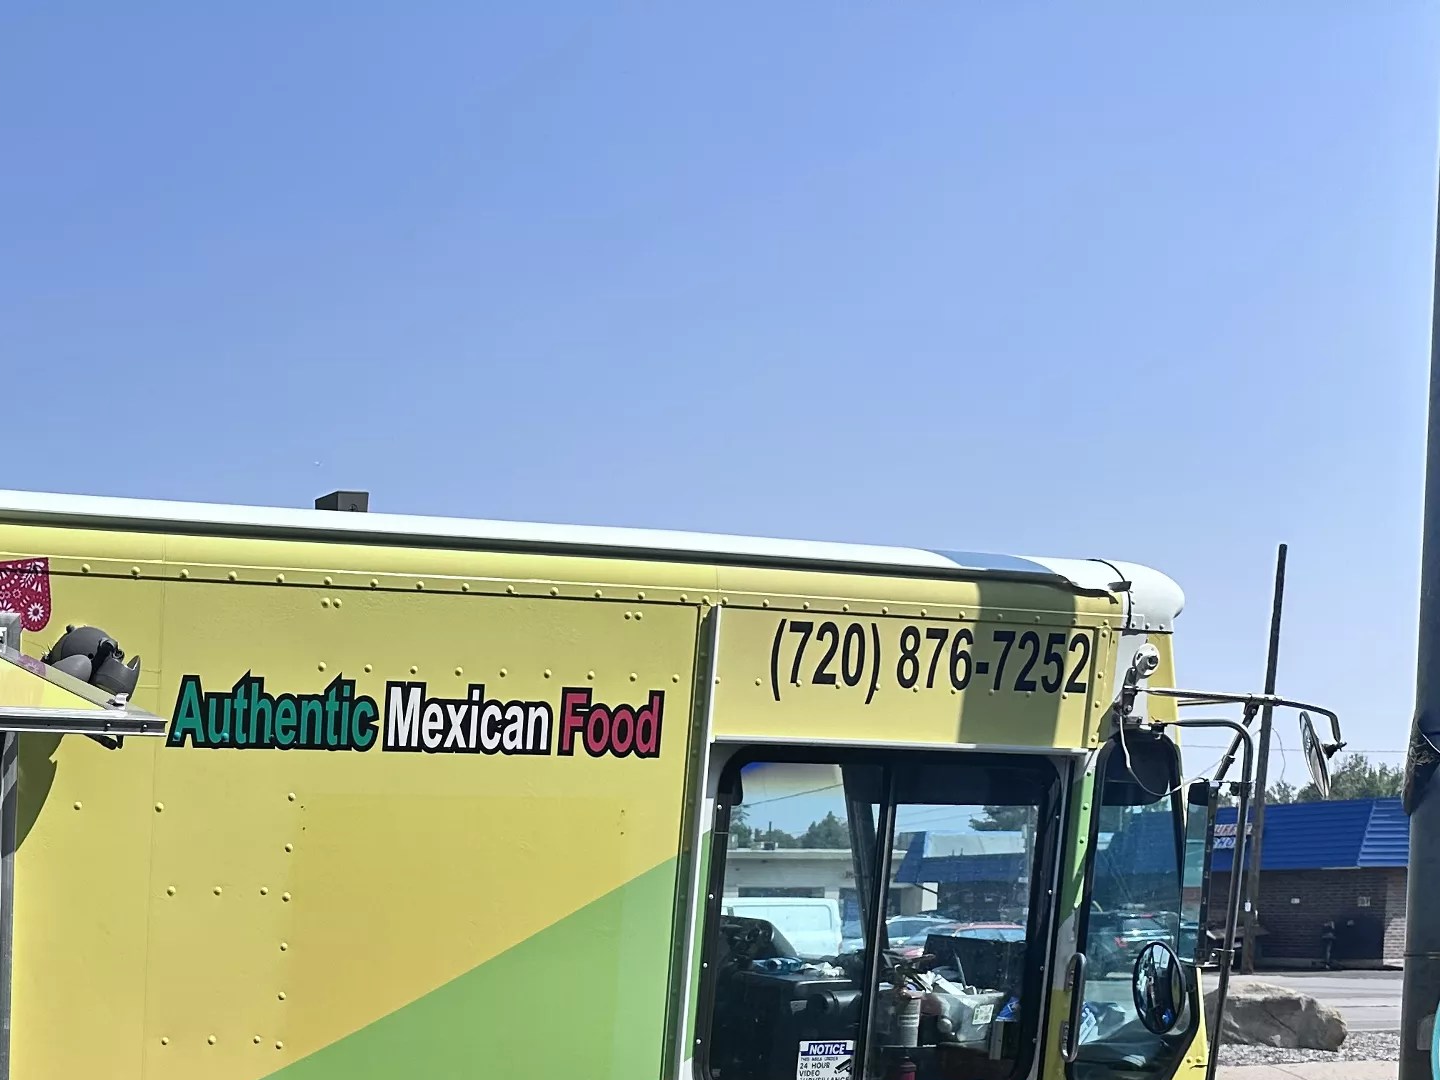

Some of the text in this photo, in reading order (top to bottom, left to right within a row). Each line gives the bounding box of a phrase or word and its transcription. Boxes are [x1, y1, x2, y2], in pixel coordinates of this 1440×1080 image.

[771, 619, 1090, 704] (720) 876-7252
[169, 673, 662, 755] Authentic Mexican Food
[809, 1043, 845, 1055] NOTICE
